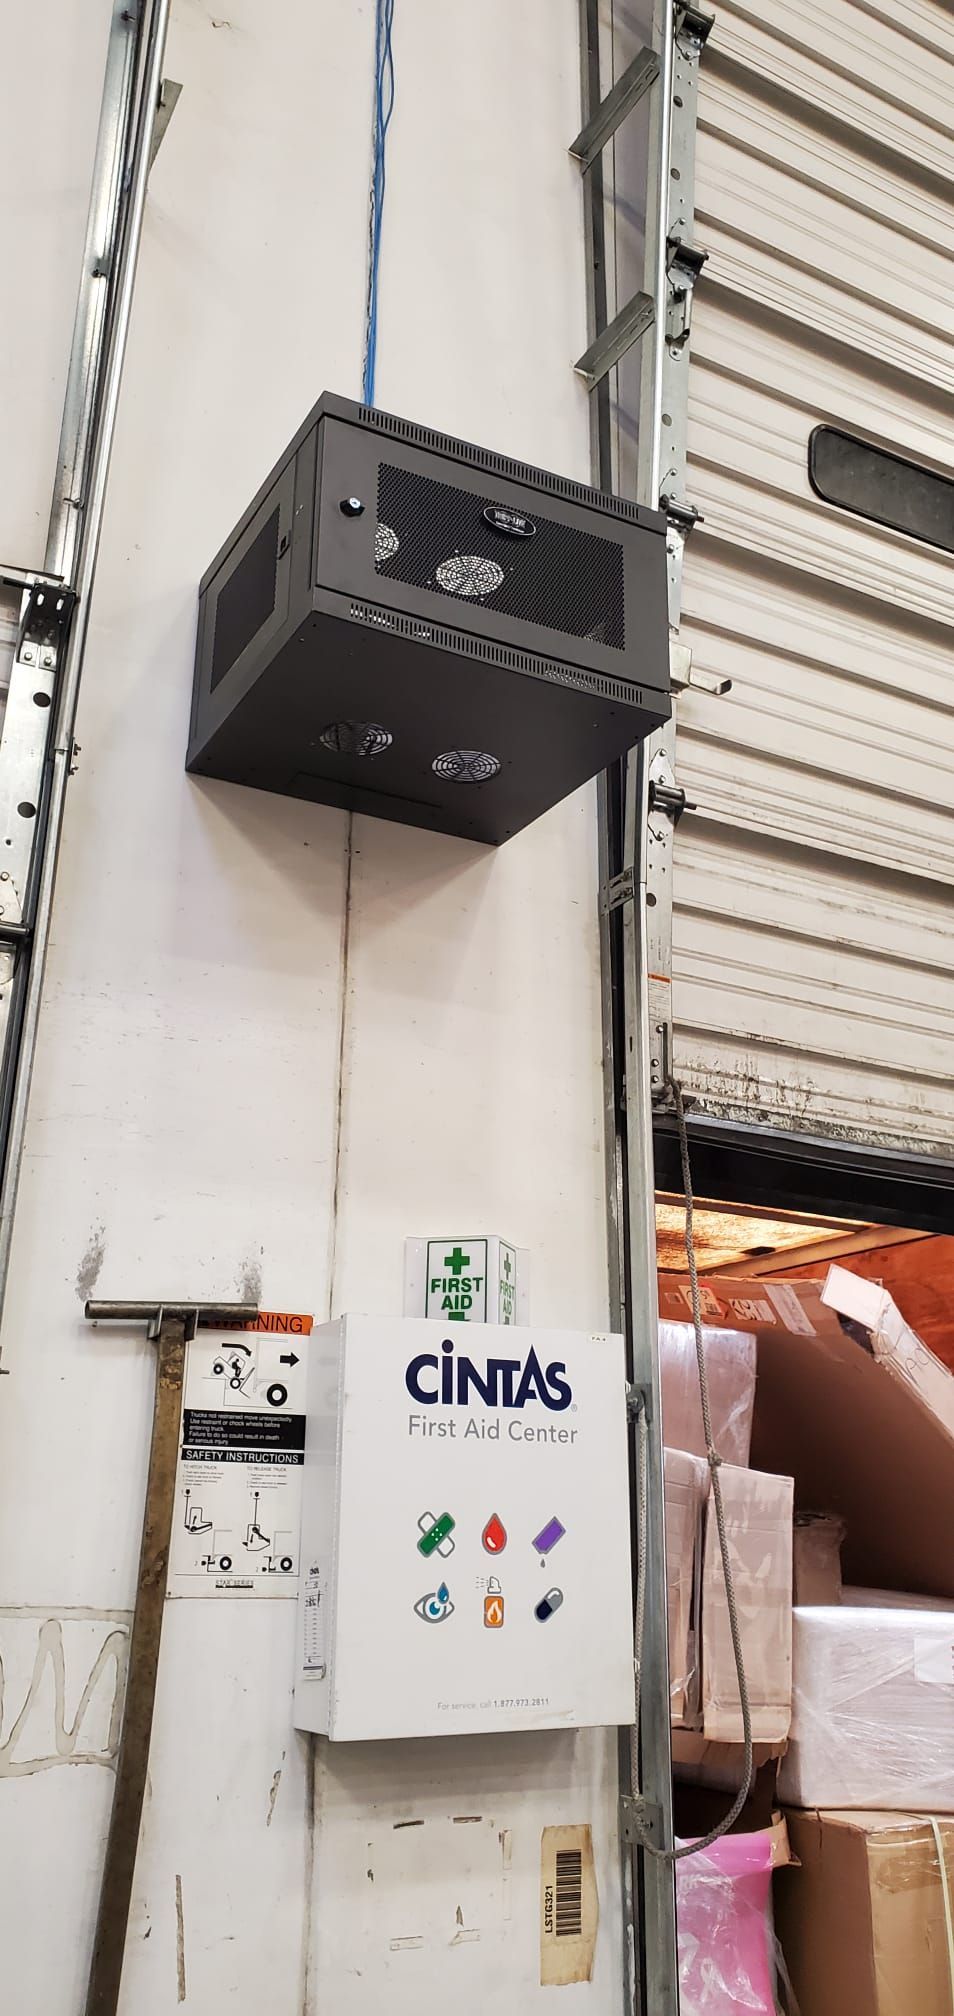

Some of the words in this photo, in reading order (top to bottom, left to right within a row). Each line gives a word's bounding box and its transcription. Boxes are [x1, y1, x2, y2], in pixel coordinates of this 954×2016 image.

[431, 1277, 484, 1293] FIRST
[500, 1280, 515, 1300] FIRST
[441, 1295, 473, 1310] AID
[503, 1299, 512, 1315] AID
[408, 1414, 456, 1438] First
[464, 1417, 500, 1440] Aid
[508, 1420, 578, 1444] Center
[186, 1450, 223, 1460] SAFETY
[226, 1452, 299, 1464] INSTRUCTIONS
[437, 1702, 450, 1710] For
[479, 1700, 492, 1709] call
[545, 1885, 553, 1934] LSTG321
